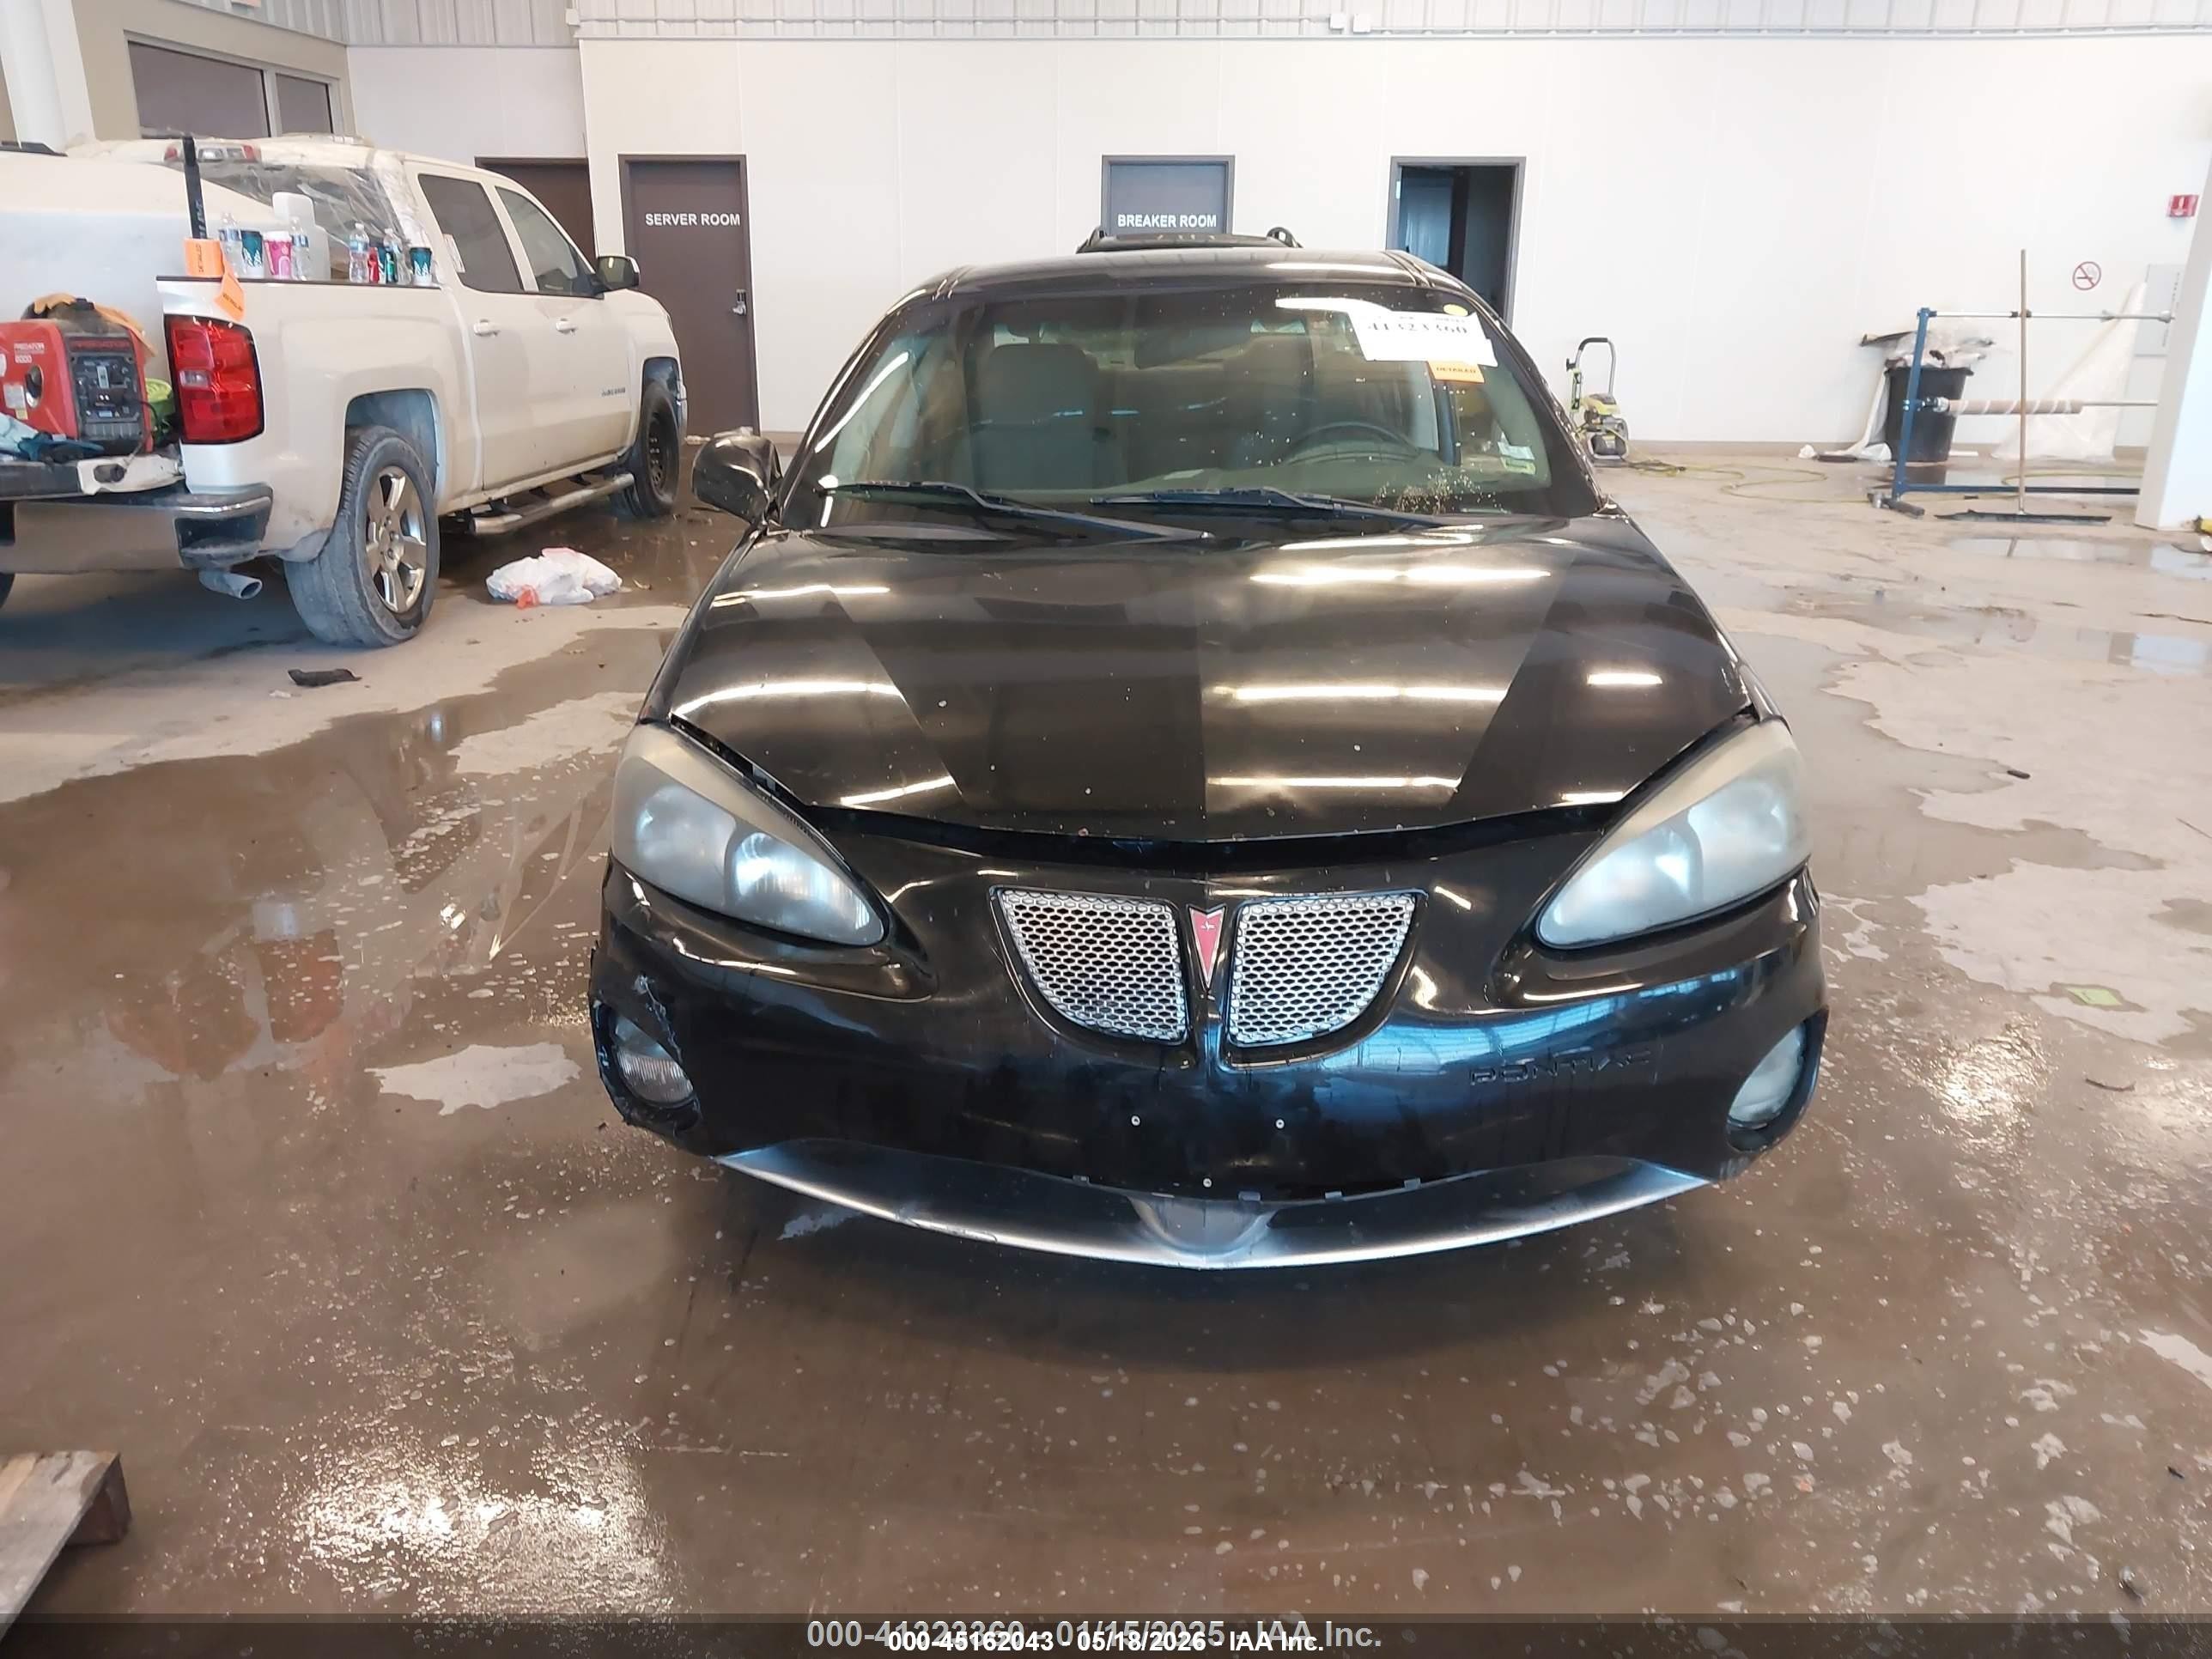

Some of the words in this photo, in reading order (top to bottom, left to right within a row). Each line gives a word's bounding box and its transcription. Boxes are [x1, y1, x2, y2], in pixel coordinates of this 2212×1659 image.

[645, 213, 698, 226] SERVER
[701, 213, 741, 226] ROOM
[1117, 214, 1176, 228] BREAKER
[1179, 214, 1217, 228] ROOM
[1470, 1046, 1651, 1085] PONTIAC
